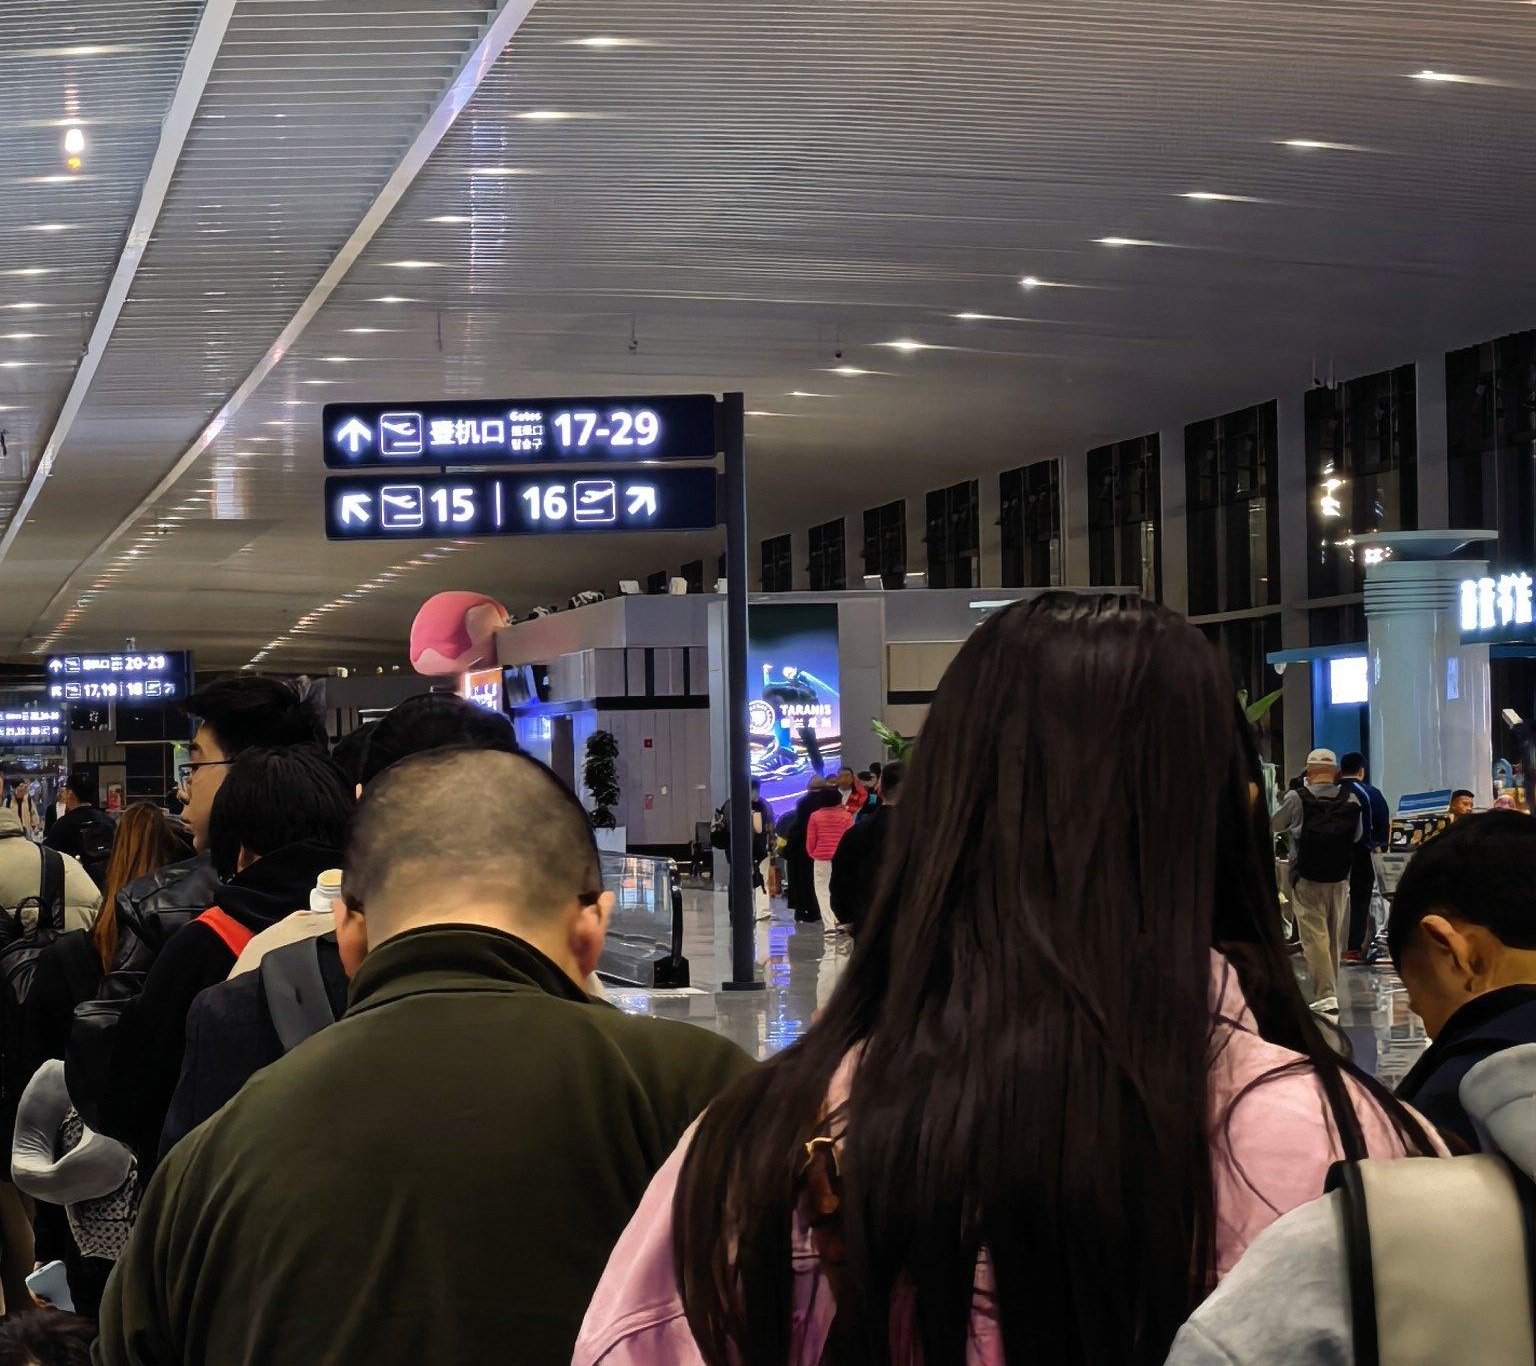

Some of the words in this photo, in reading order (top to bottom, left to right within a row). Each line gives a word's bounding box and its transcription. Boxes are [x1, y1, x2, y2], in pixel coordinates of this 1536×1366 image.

[430, 420, 505, 445] 登机口
[554, 411, 659, 446] 17-29
[430, 488, 475, 522] 15
[522, 485, 567, 520] 16
[779, 704, 832, 716] TARANIS
